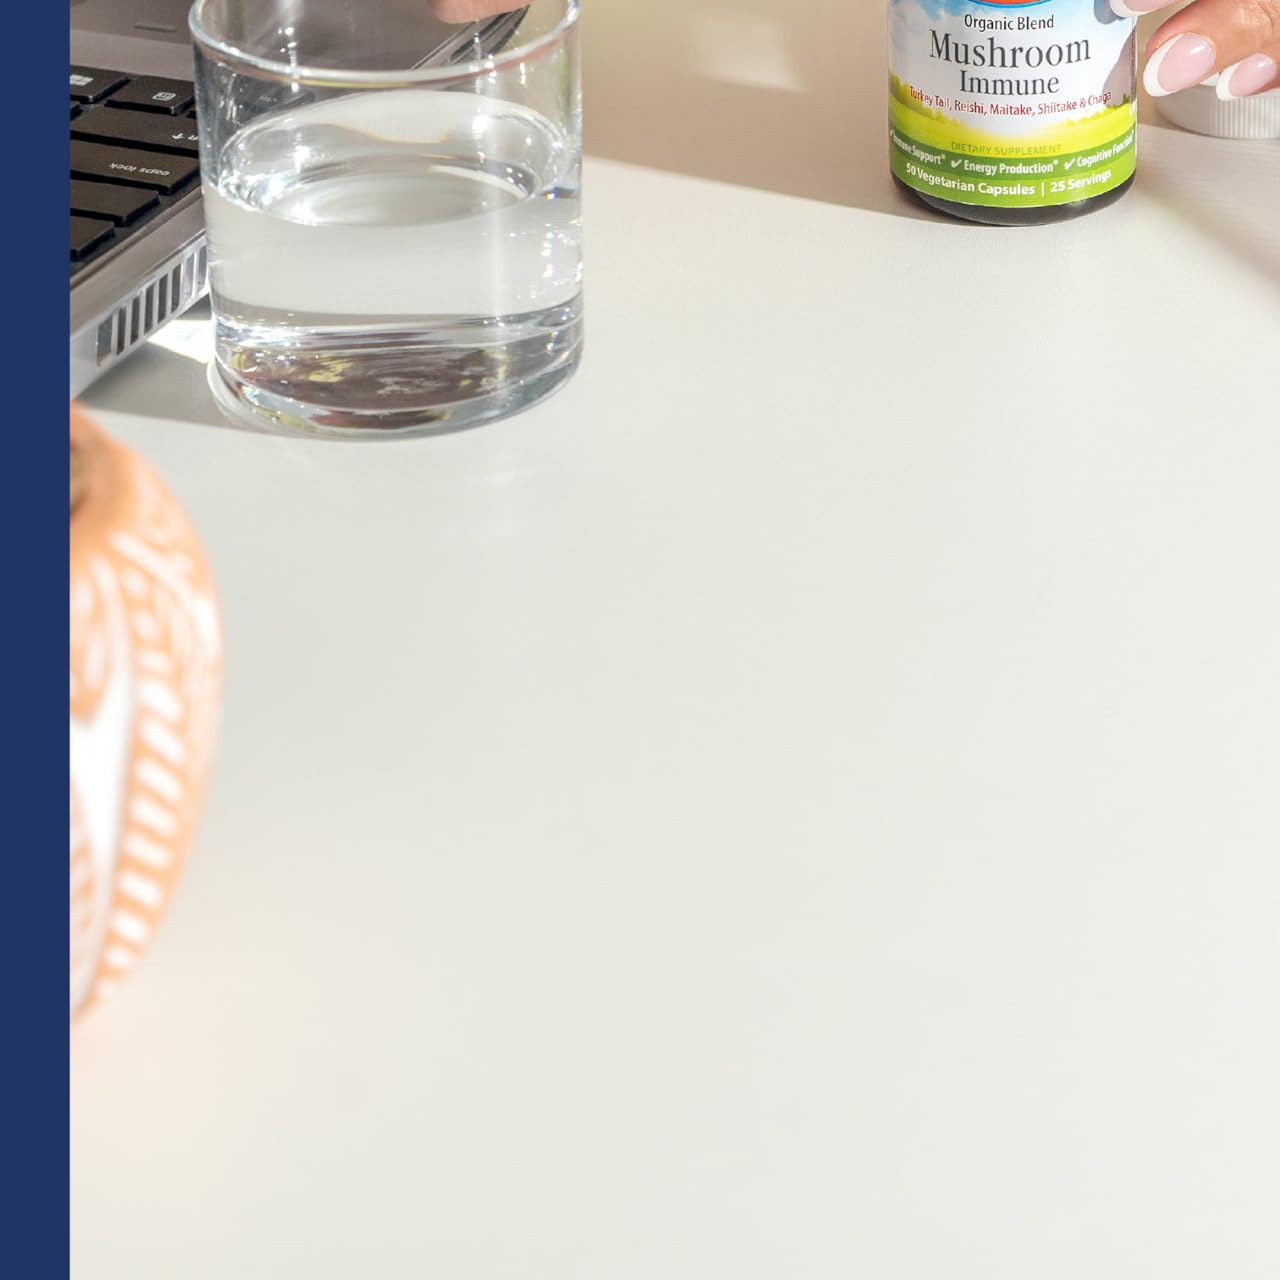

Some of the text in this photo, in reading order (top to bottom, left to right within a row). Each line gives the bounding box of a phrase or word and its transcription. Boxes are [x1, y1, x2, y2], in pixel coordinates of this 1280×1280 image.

[964, 14, 1054, 32] Organic Blend
[929, 28, 1091, 68] Mushroom
[960, 70, 1059, 95] Immune
[909, 85, 1112, 117] Turkey Tail, Reishi, Maitake, Shiitake & Chaga
[951, 141, 1061, 156] DIETARY SUPPLEMENT
[964, 160, 997, 176] Energy
[1077, 150, 1112, 167] Cognitive
[906, 162, 916, 176] 50
[917, 167, 975, 192] Vegetarian
[977, 182, 1036, 197] Capsules
[1050, 181, 1065, 192] 25
[1068, 168, 1111, 188] Servings
